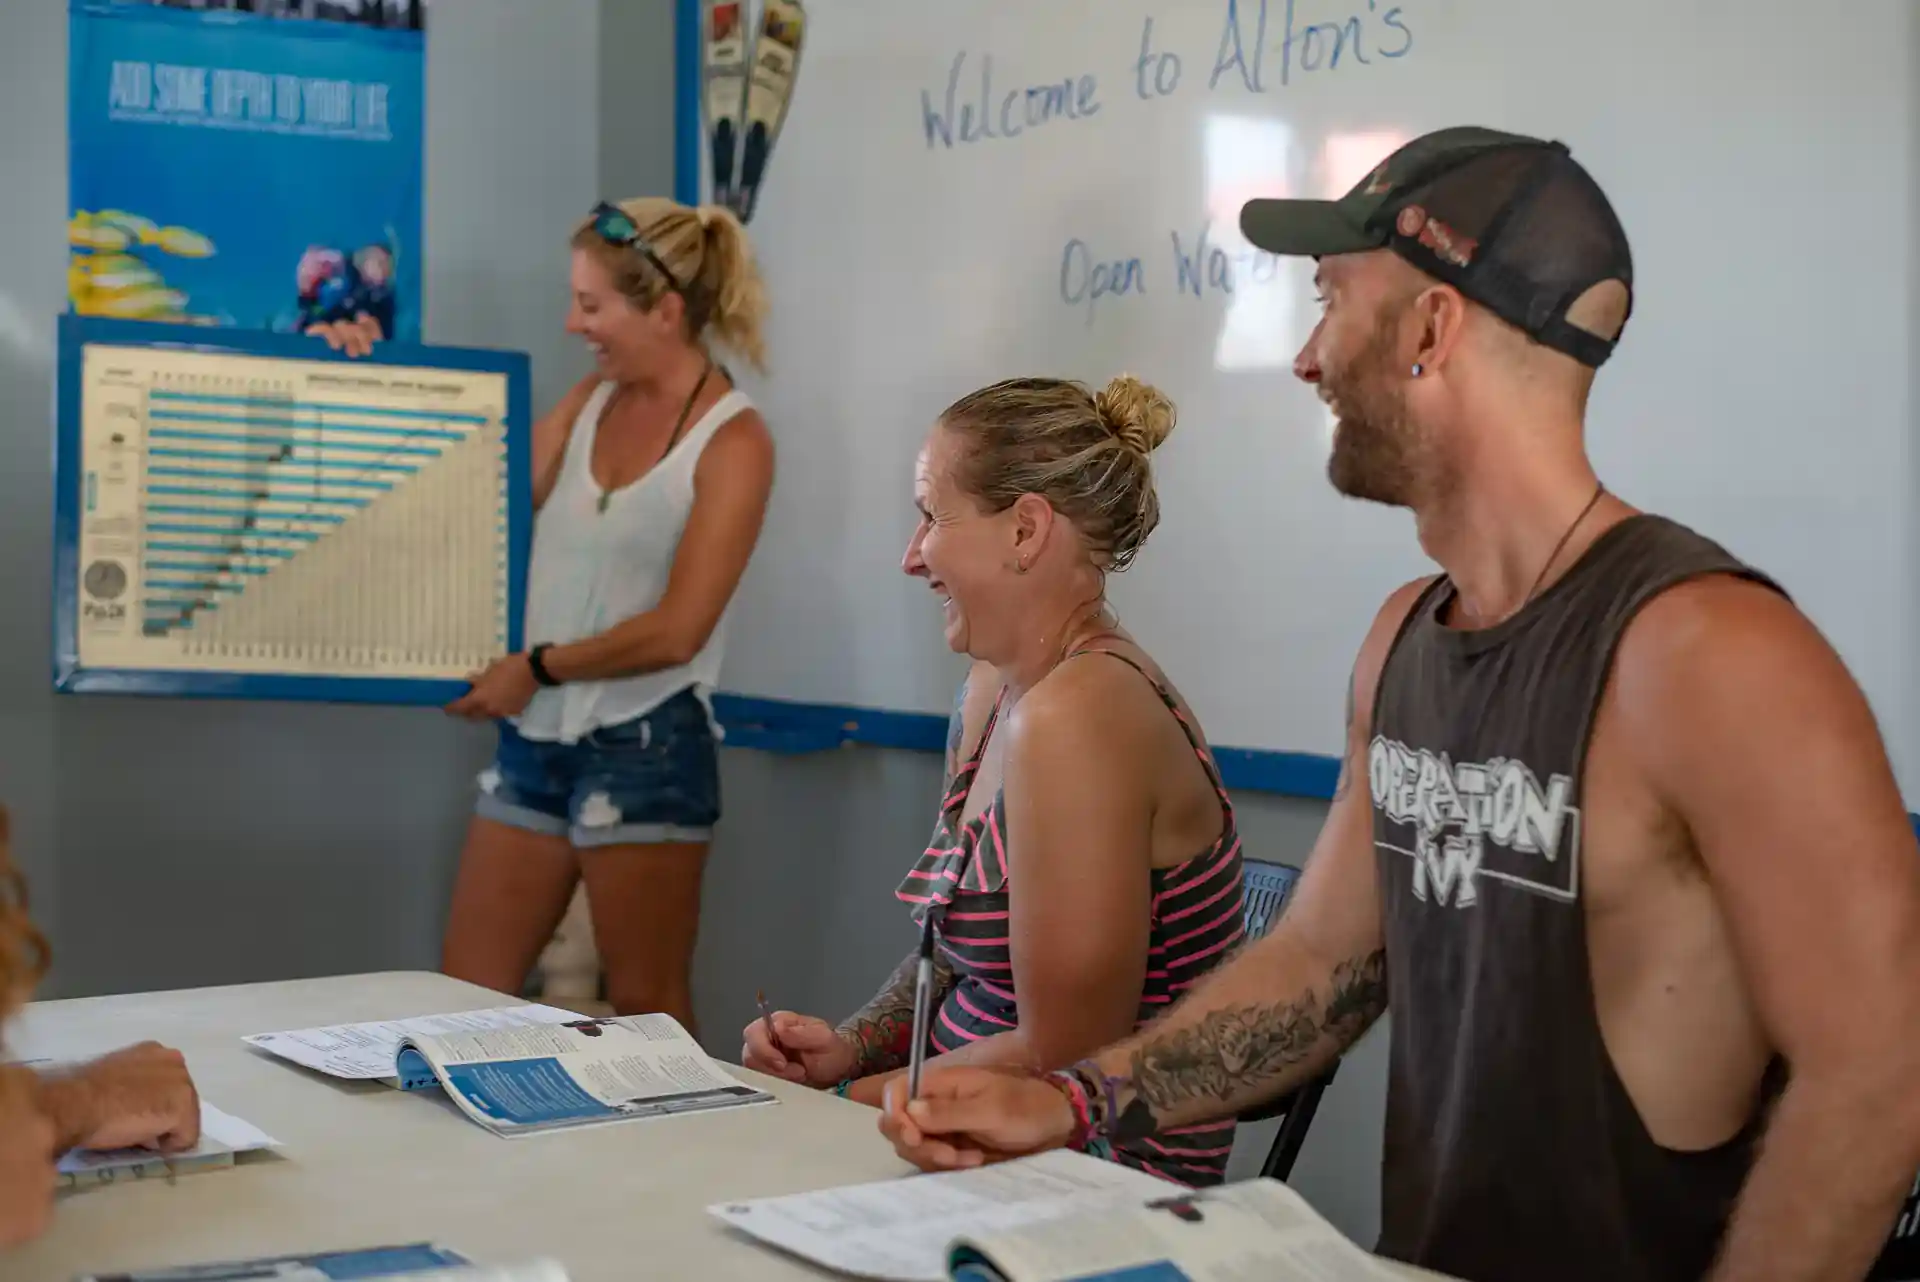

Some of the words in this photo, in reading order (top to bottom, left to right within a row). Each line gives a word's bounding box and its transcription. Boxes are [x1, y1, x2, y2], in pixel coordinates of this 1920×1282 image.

[920, 50, 1101, 151] Welcome
[1131, 15, 1182, 100] to
[1059, 237, 1148, 327] Open
[1170, 219, 1279, 300] Wate
[1368, 734, 1573, 863] OPERATION
